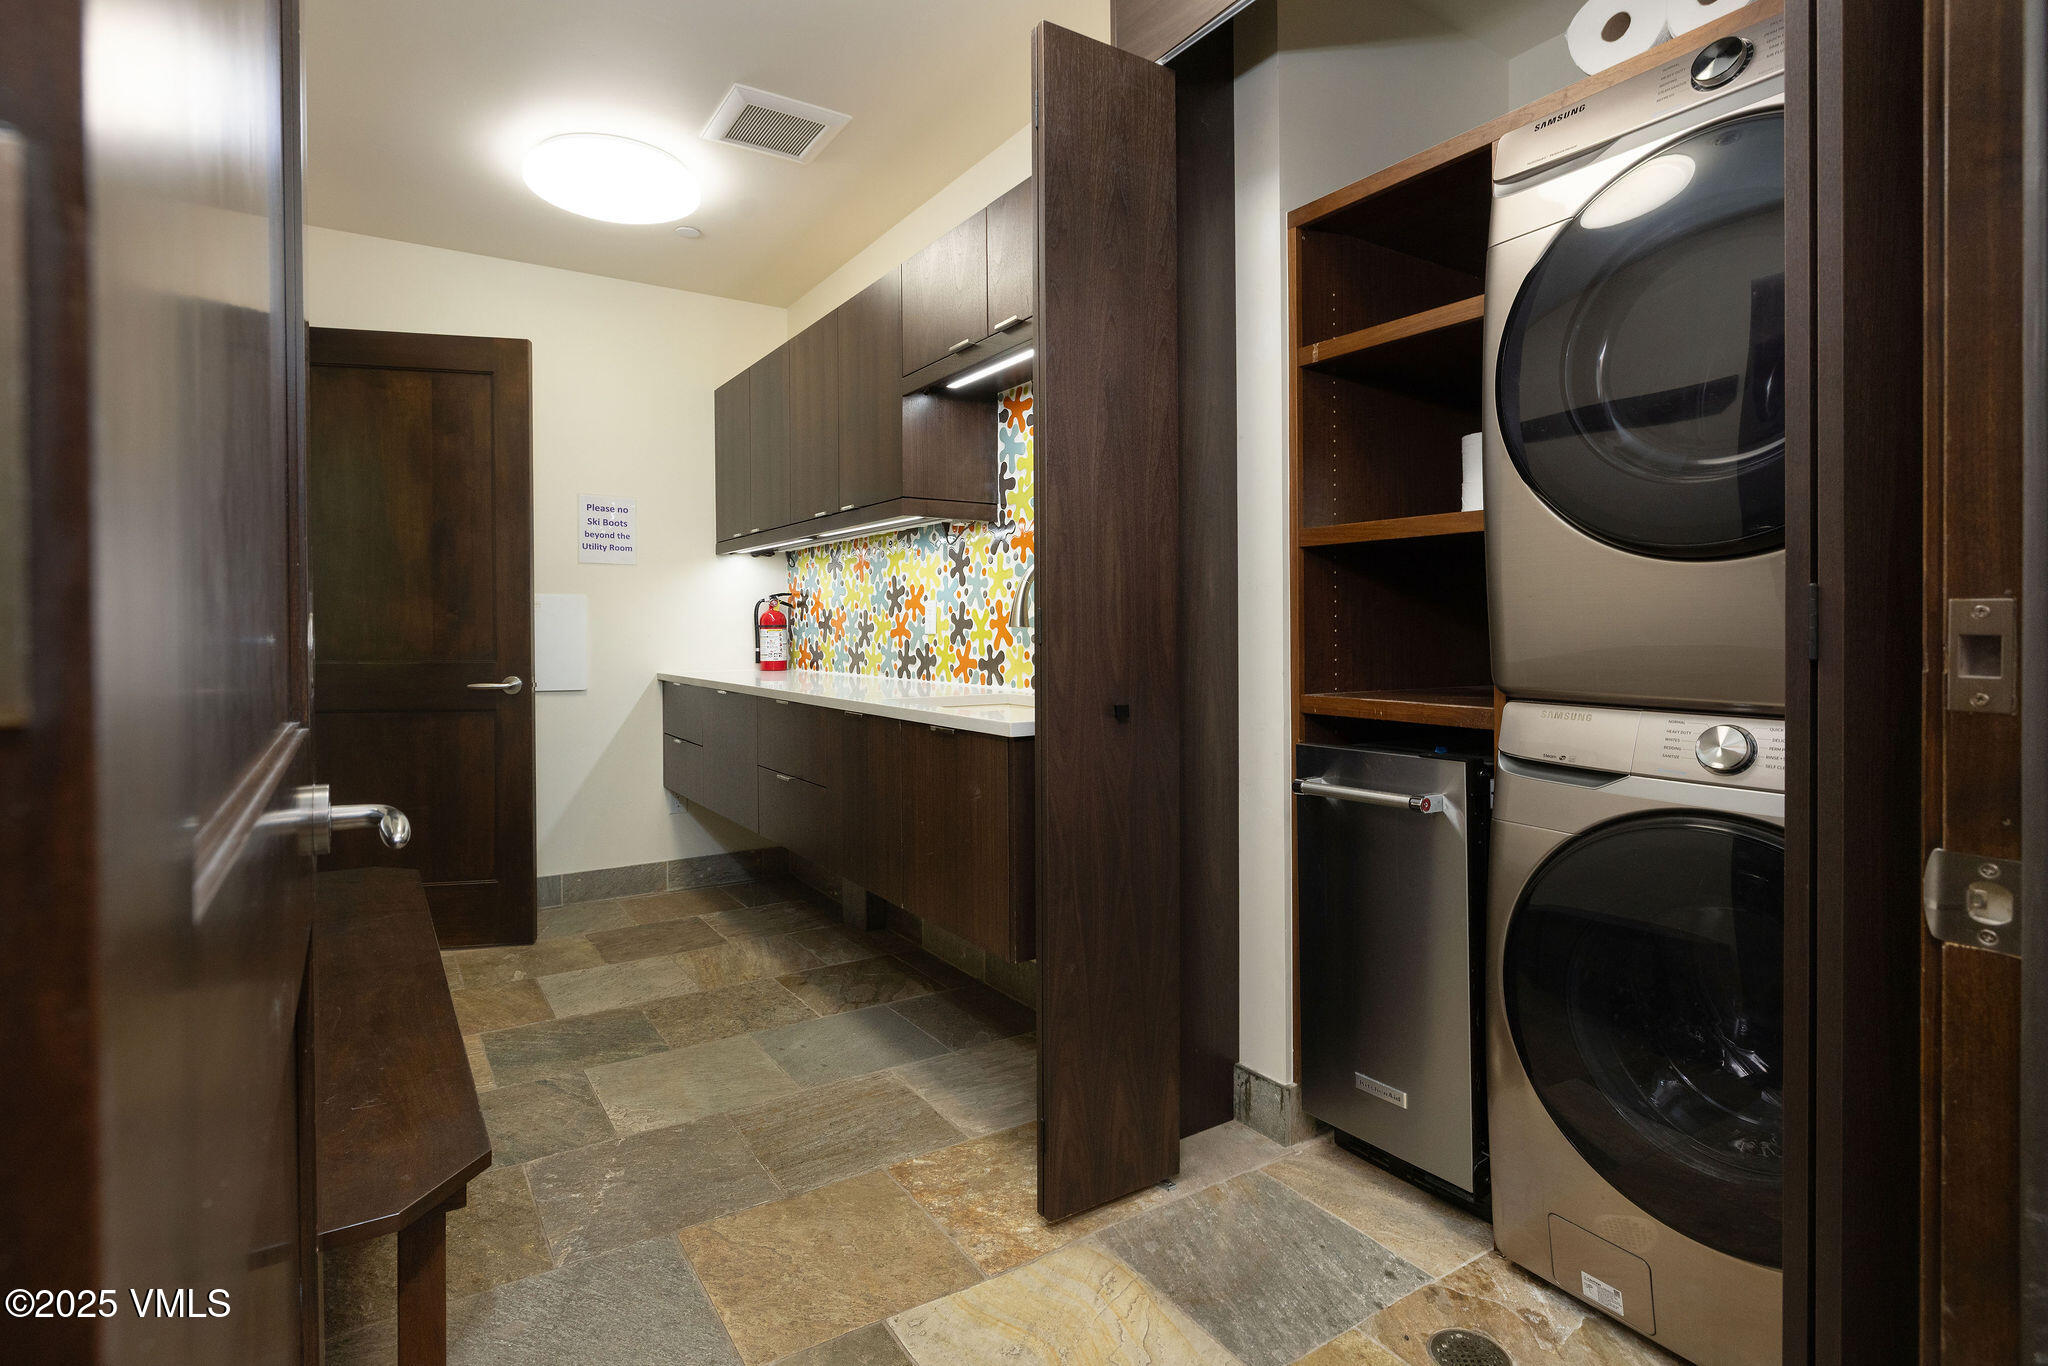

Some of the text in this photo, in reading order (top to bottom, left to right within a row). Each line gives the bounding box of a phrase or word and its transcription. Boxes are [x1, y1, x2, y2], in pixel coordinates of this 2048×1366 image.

[1534, 104, 1586, 132] SAMSUNG
[586, 503, 615, 513] Please
[587, 517, 628, 528] Ski Boots
[584, 530, 631, 540] beyond the
[582, 542, 633, 552] Utility Room
[1541, 710, 1592, 722] SAMSUNG
[1359, 1079, 1401, 1102] KitchenAid
